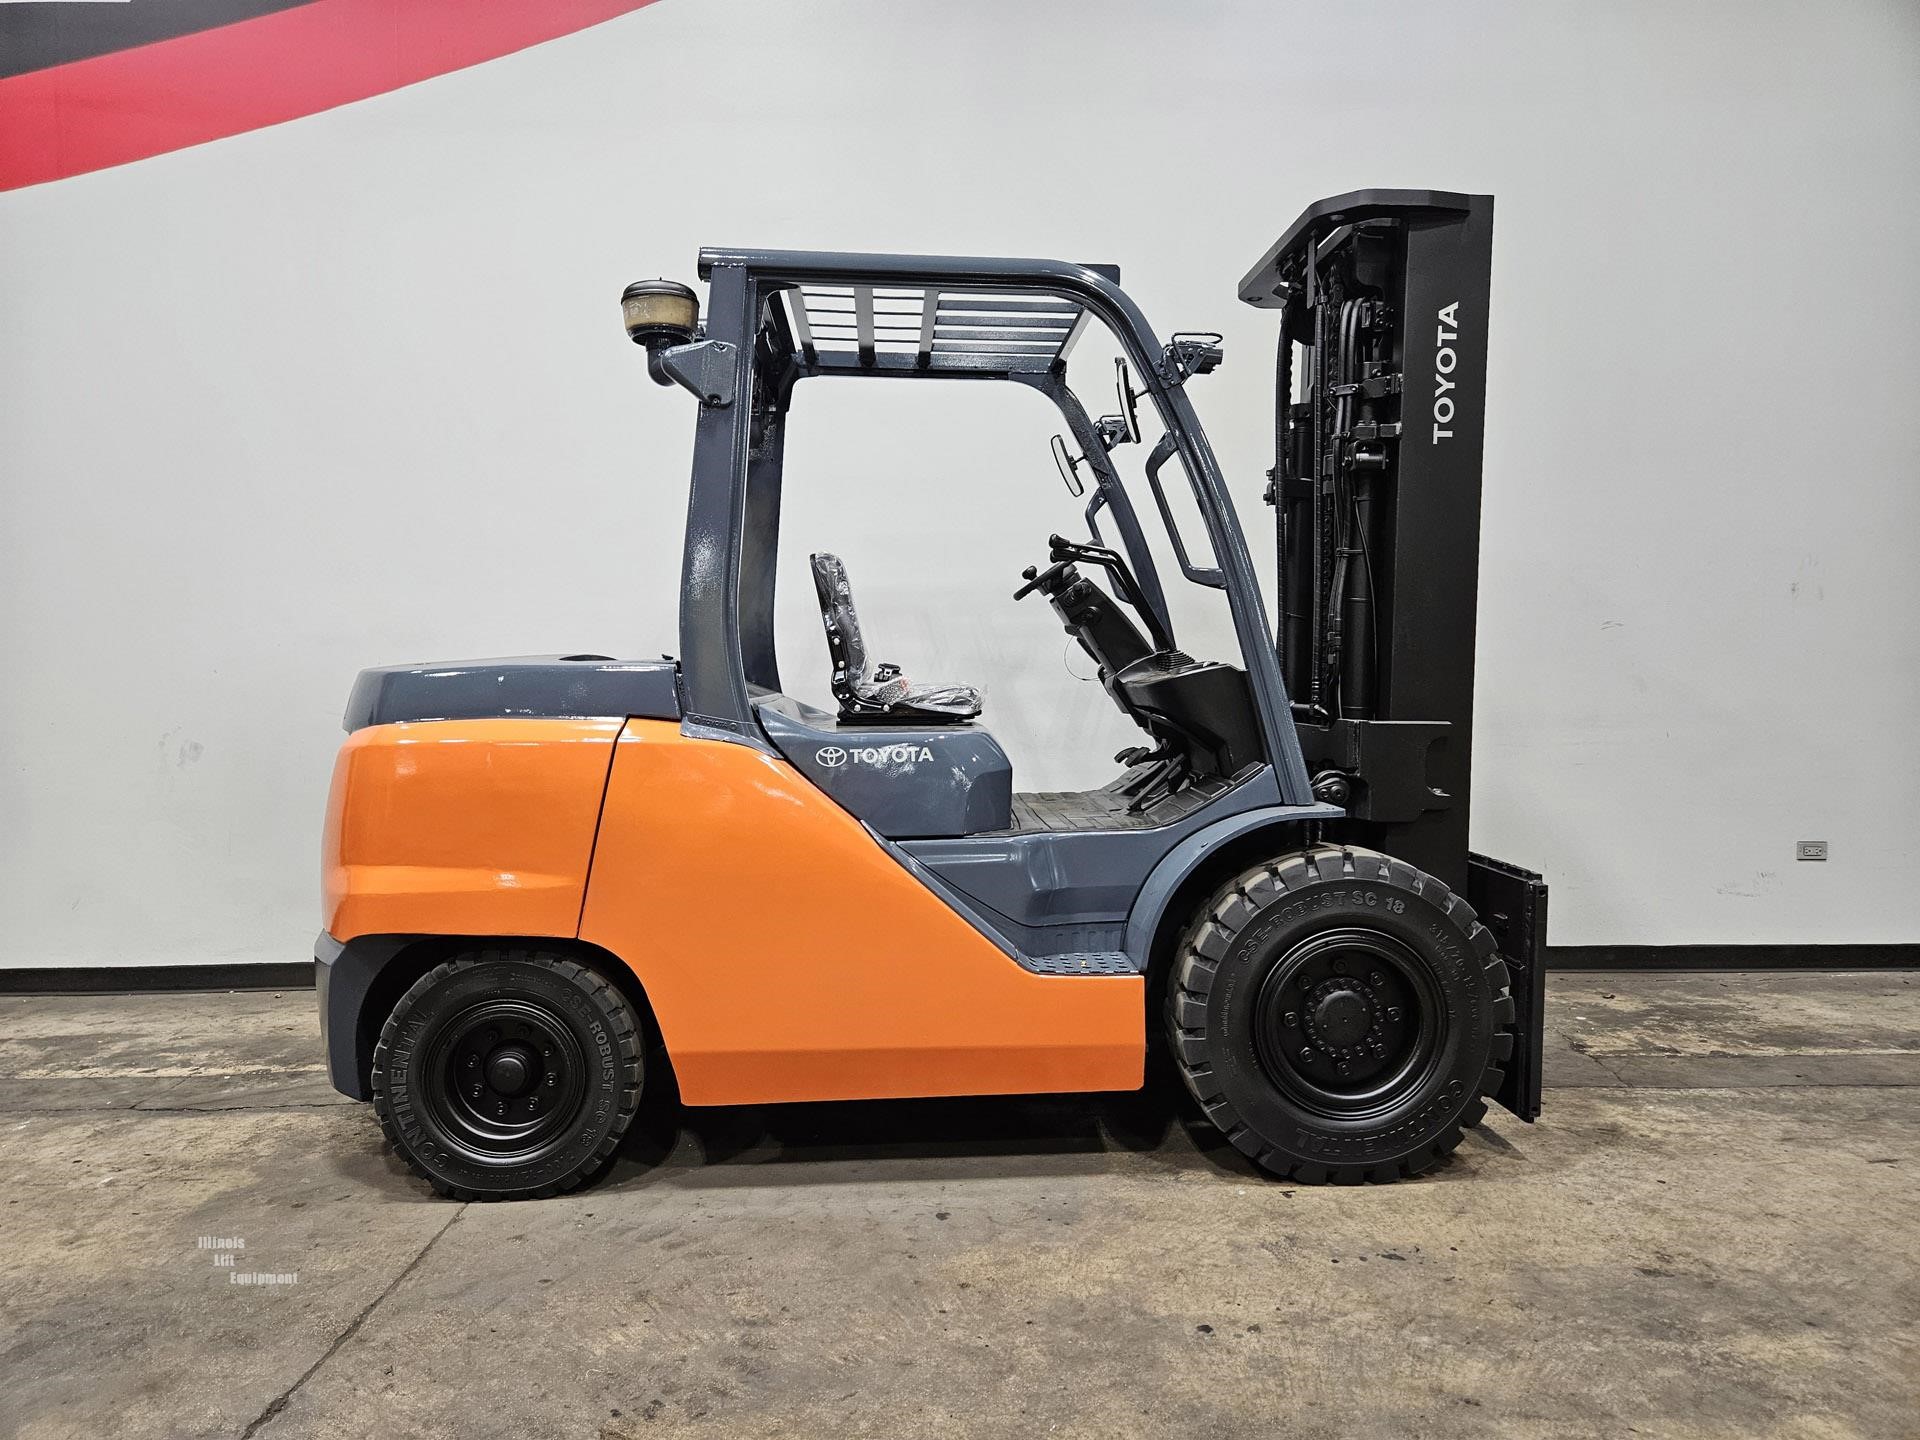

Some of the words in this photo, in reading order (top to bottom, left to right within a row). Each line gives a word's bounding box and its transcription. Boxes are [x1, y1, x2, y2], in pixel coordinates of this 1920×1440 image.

[1433, 301, 1459, 445] TOYOTA
[849, 747, 934, 763] TOYOTA
[1351, 890, 1378, 907] SC
[1385, 897, 1406, 914] 18
